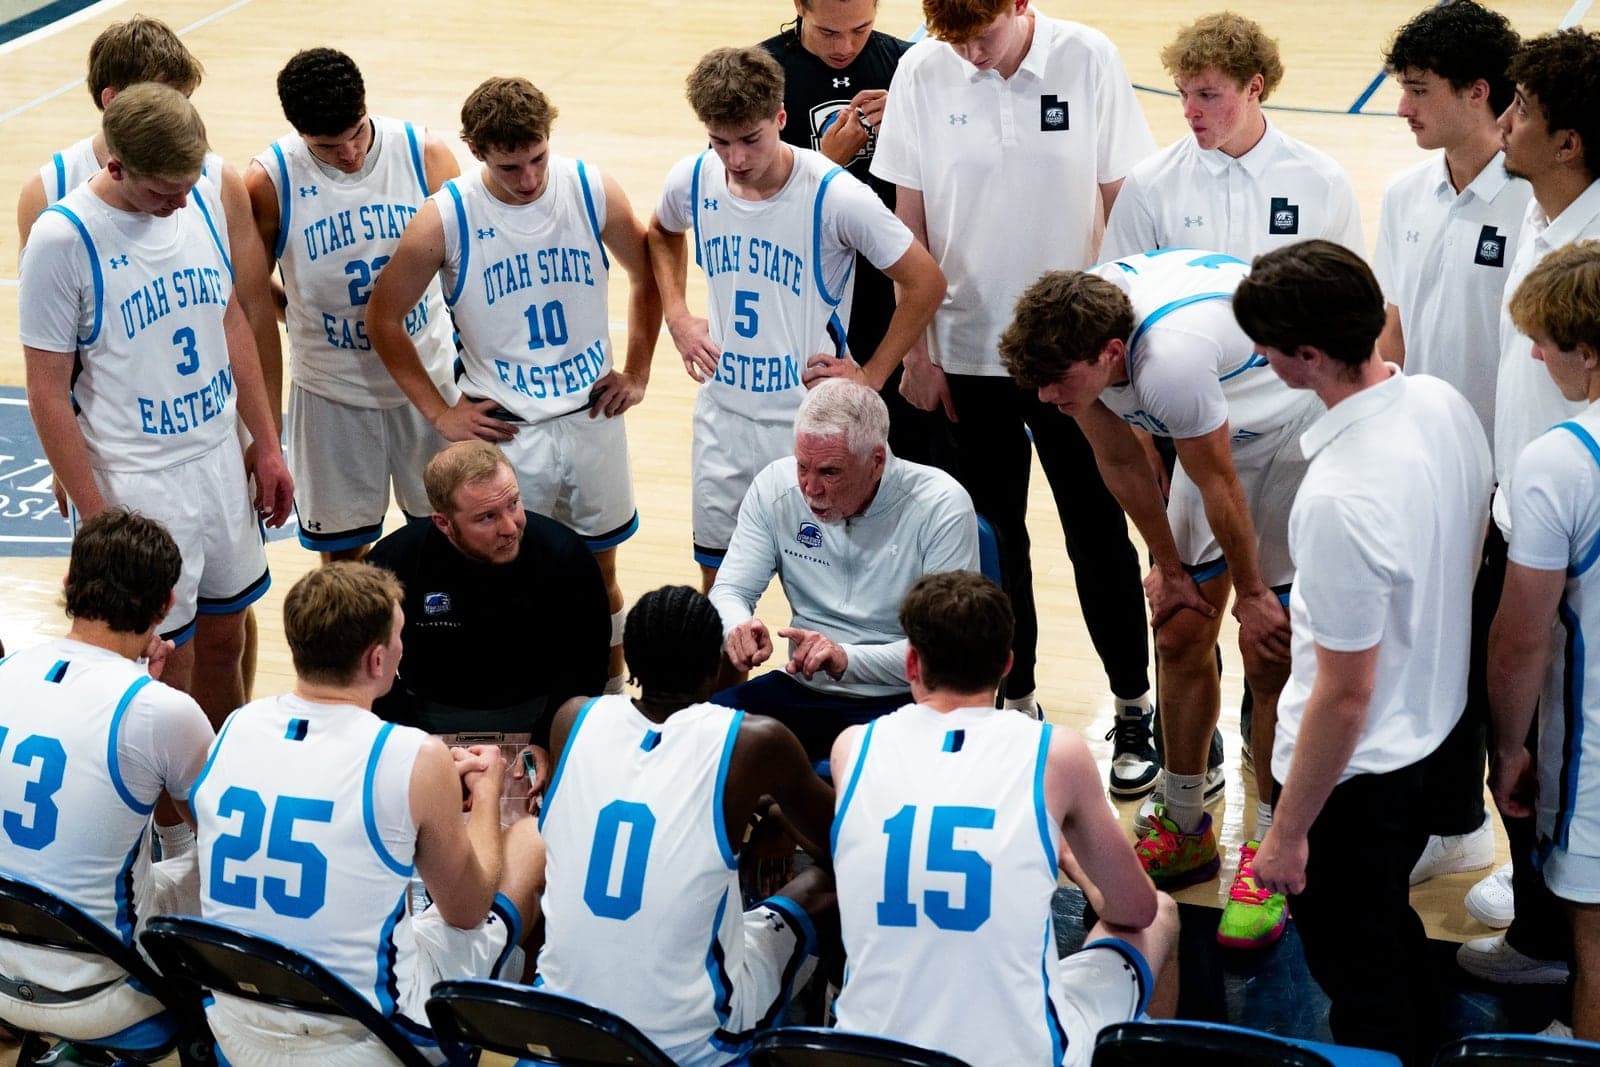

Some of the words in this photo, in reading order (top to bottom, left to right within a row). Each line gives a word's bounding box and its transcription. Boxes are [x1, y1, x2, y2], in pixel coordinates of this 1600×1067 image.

[304, 210, 356, 262] UTAH
[706, 235, 742, 278] UTAH
[748, 237, 803, 297] STATE
[120, 276, 170, 340] UTAH
[172, 267, 227, 309] STATE
[483, 252, 532, 305] UTAH
[537, 247, 594, 286] STATE
[523, 299, 569, 350] 10
[734, 290, 760, 339] 5
[172, 326, 200, 377] 3
[495, 339, 605, 399] EASTERN
[714, 351, 801, 393] STERN
[137, 363, 233, 435] EASTERN
[0, 725, 67, 851] 3
[209, 785, 335, 919] 25
[583, 800, 656, 921] 0
[877, 804, 996, 932] 15
